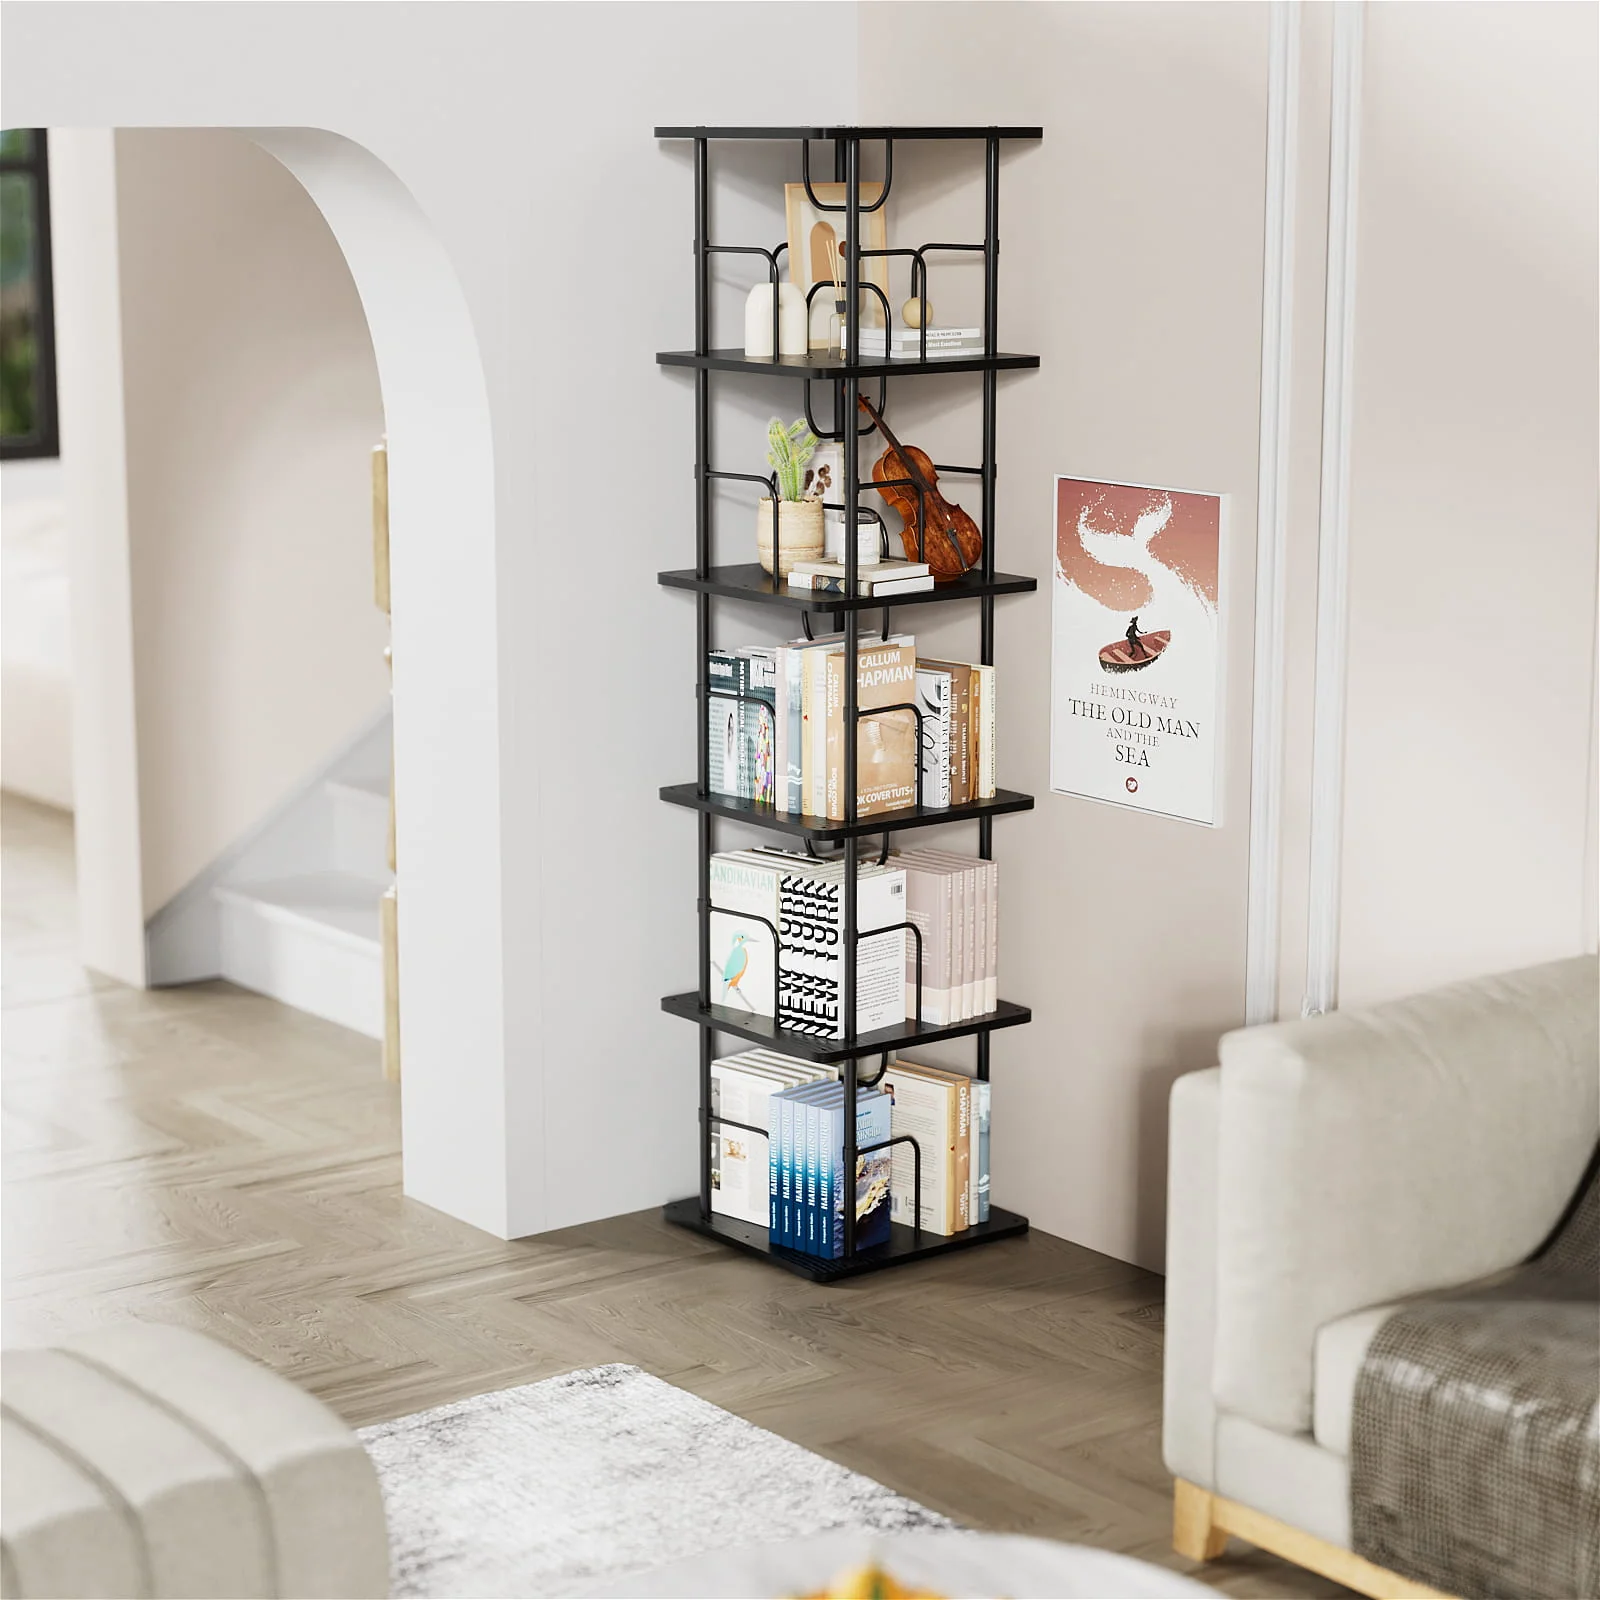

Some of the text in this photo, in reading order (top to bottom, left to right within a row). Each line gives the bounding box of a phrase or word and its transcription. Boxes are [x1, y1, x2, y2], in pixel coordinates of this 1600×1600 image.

[860, 651, 900, 668] CALLUM
[857, 665, 913, 688] HAPMAN
[1090, 682, 1178, 710] HEMINGWAY
[1068, 698, 1200, 739] THE OLD MAN
[1106, 727, 1160, 747] AND THE
[1115, 744, 1150, 768] SEA
[866, 790, 891, 803] COVER
[892, 786, 913, 798] TUTS+
[791, 878, 802, 1031] NEW YORK
[803, 880, 814, 1034] NEW YORK
[815, 883, 826, 1037] NEW YORK
[826, 885, 838, 1039] NEW YORK
